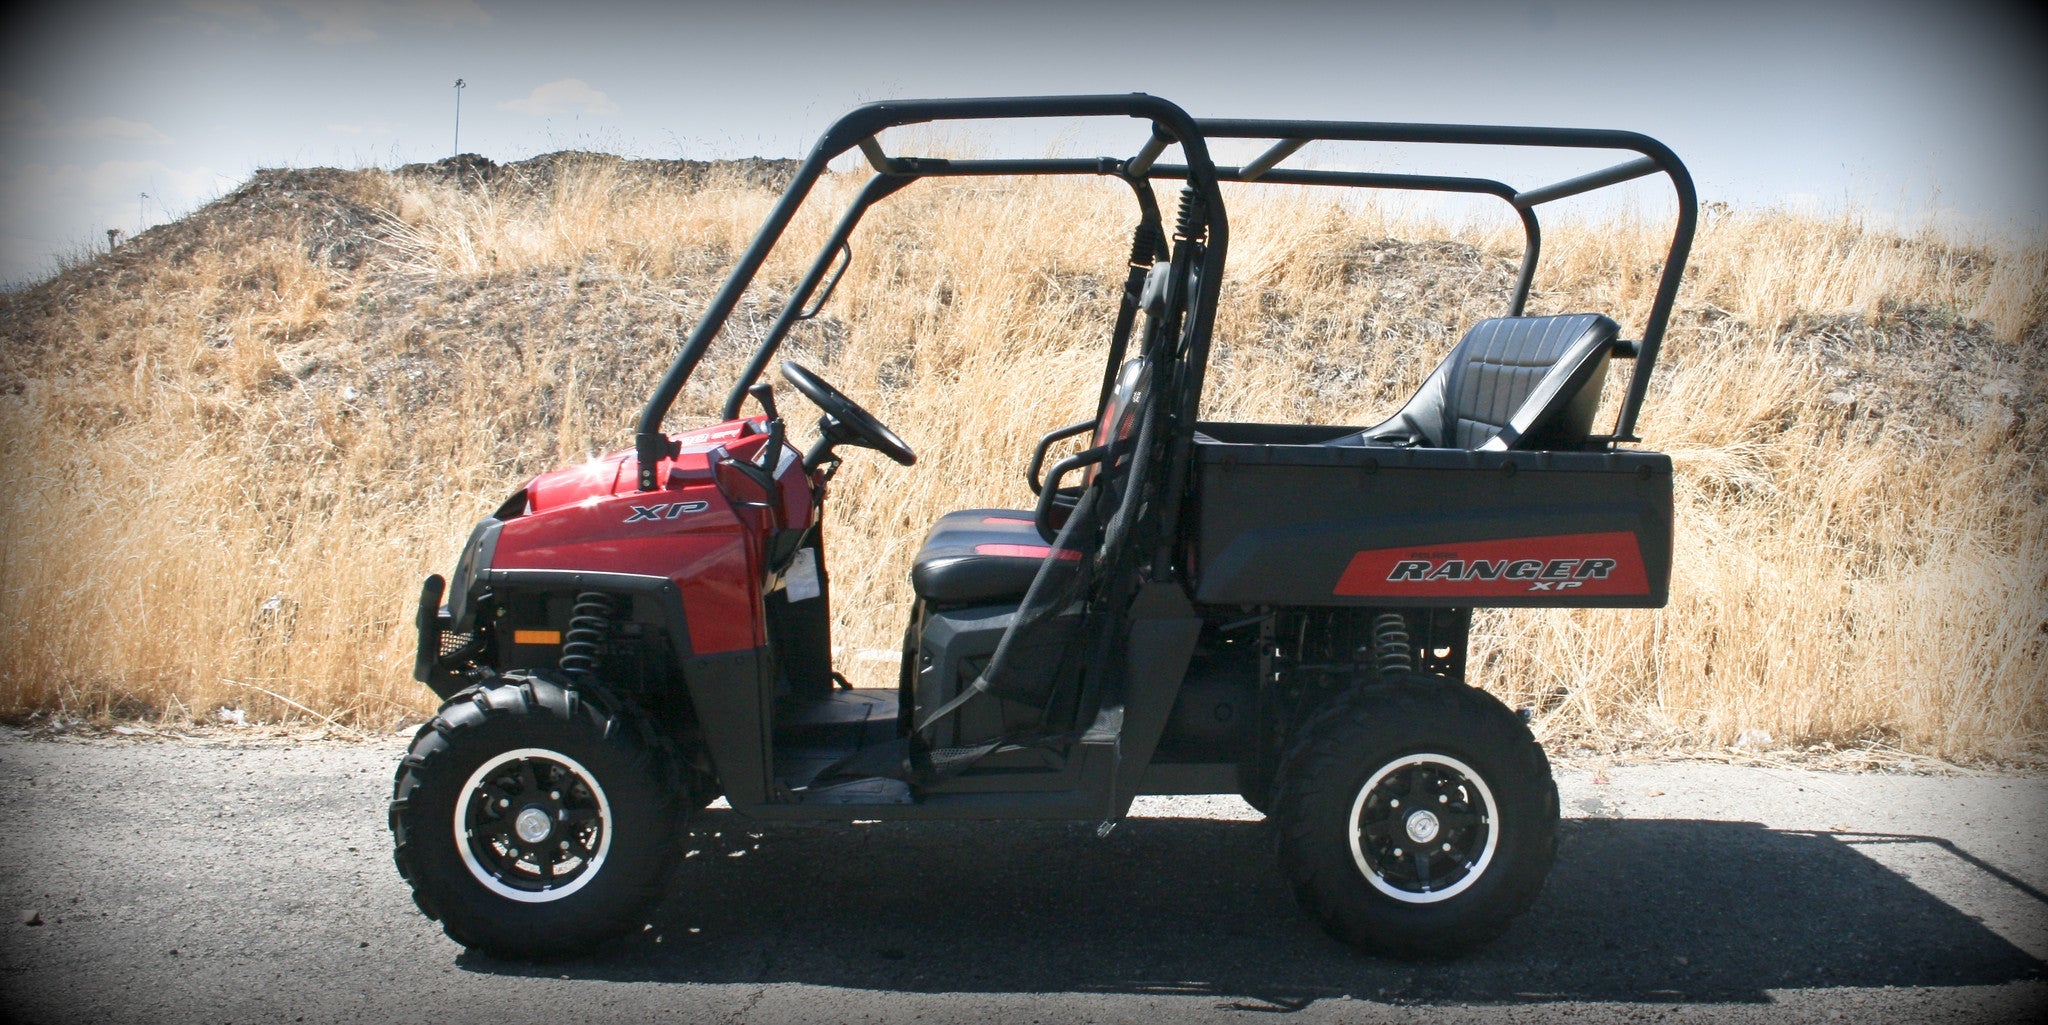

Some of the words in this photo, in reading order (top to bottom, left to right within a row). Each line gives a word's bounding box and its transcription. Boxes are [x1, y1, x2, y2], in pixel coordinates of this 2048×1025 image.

[622, 500, 709, 523] XP
[1386, 558, 1617, 581] RANGER
[1528, 581, 1584, 591] XP
